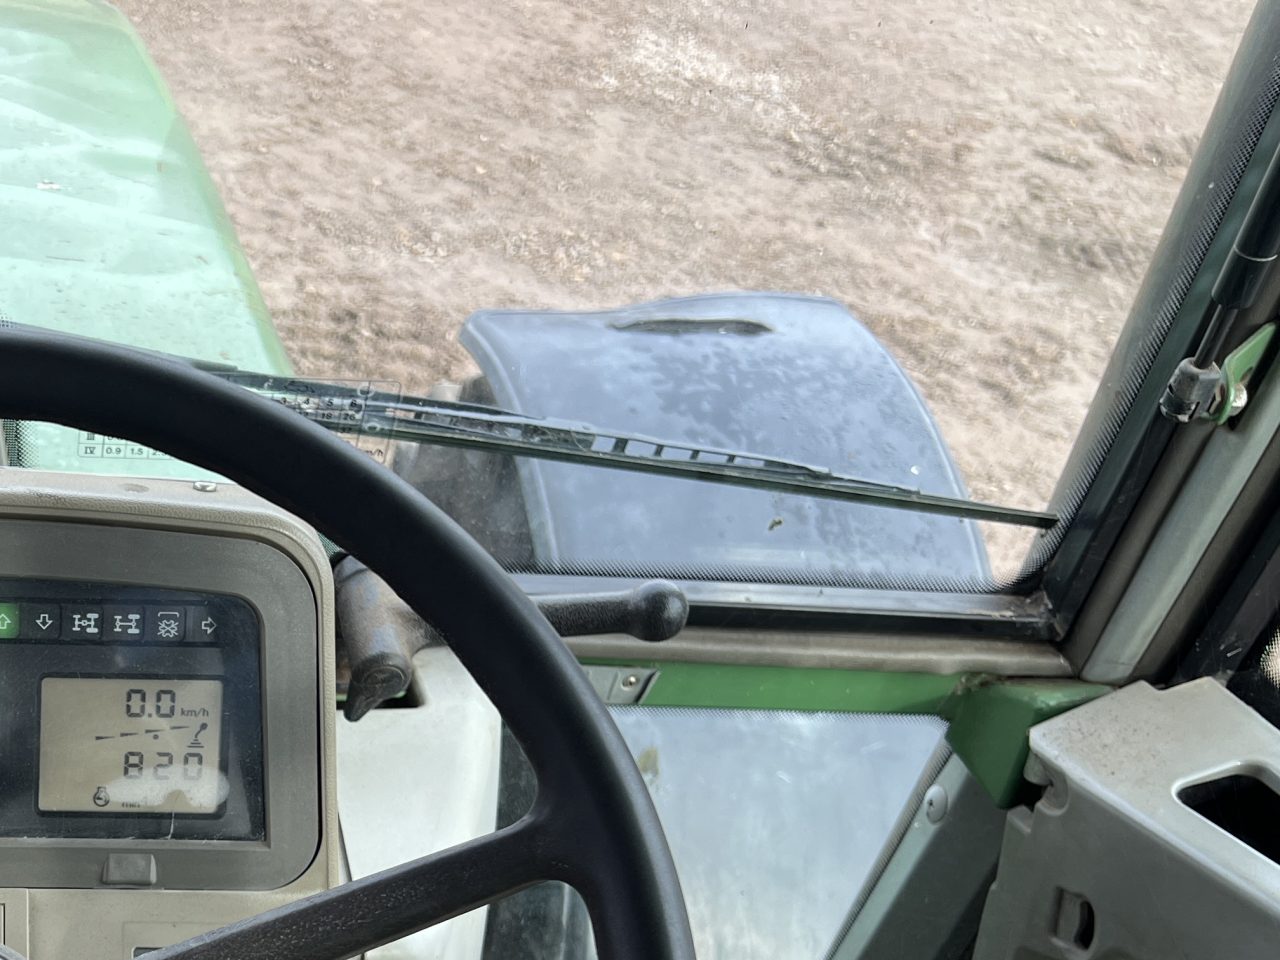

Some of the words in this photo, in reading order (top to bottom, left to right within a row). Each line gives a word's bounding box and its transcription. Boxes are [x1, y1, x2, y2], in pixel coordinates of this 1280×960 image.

[84, 446, 96, 455] IV
[105, 447, 122, 455] 0.9
[130, 448, 144, 456] 1.5
[126, 689, 176, 718] 0.0
[180, 707, 209, 718] km/h
[123, 751, 203, 781] 820
